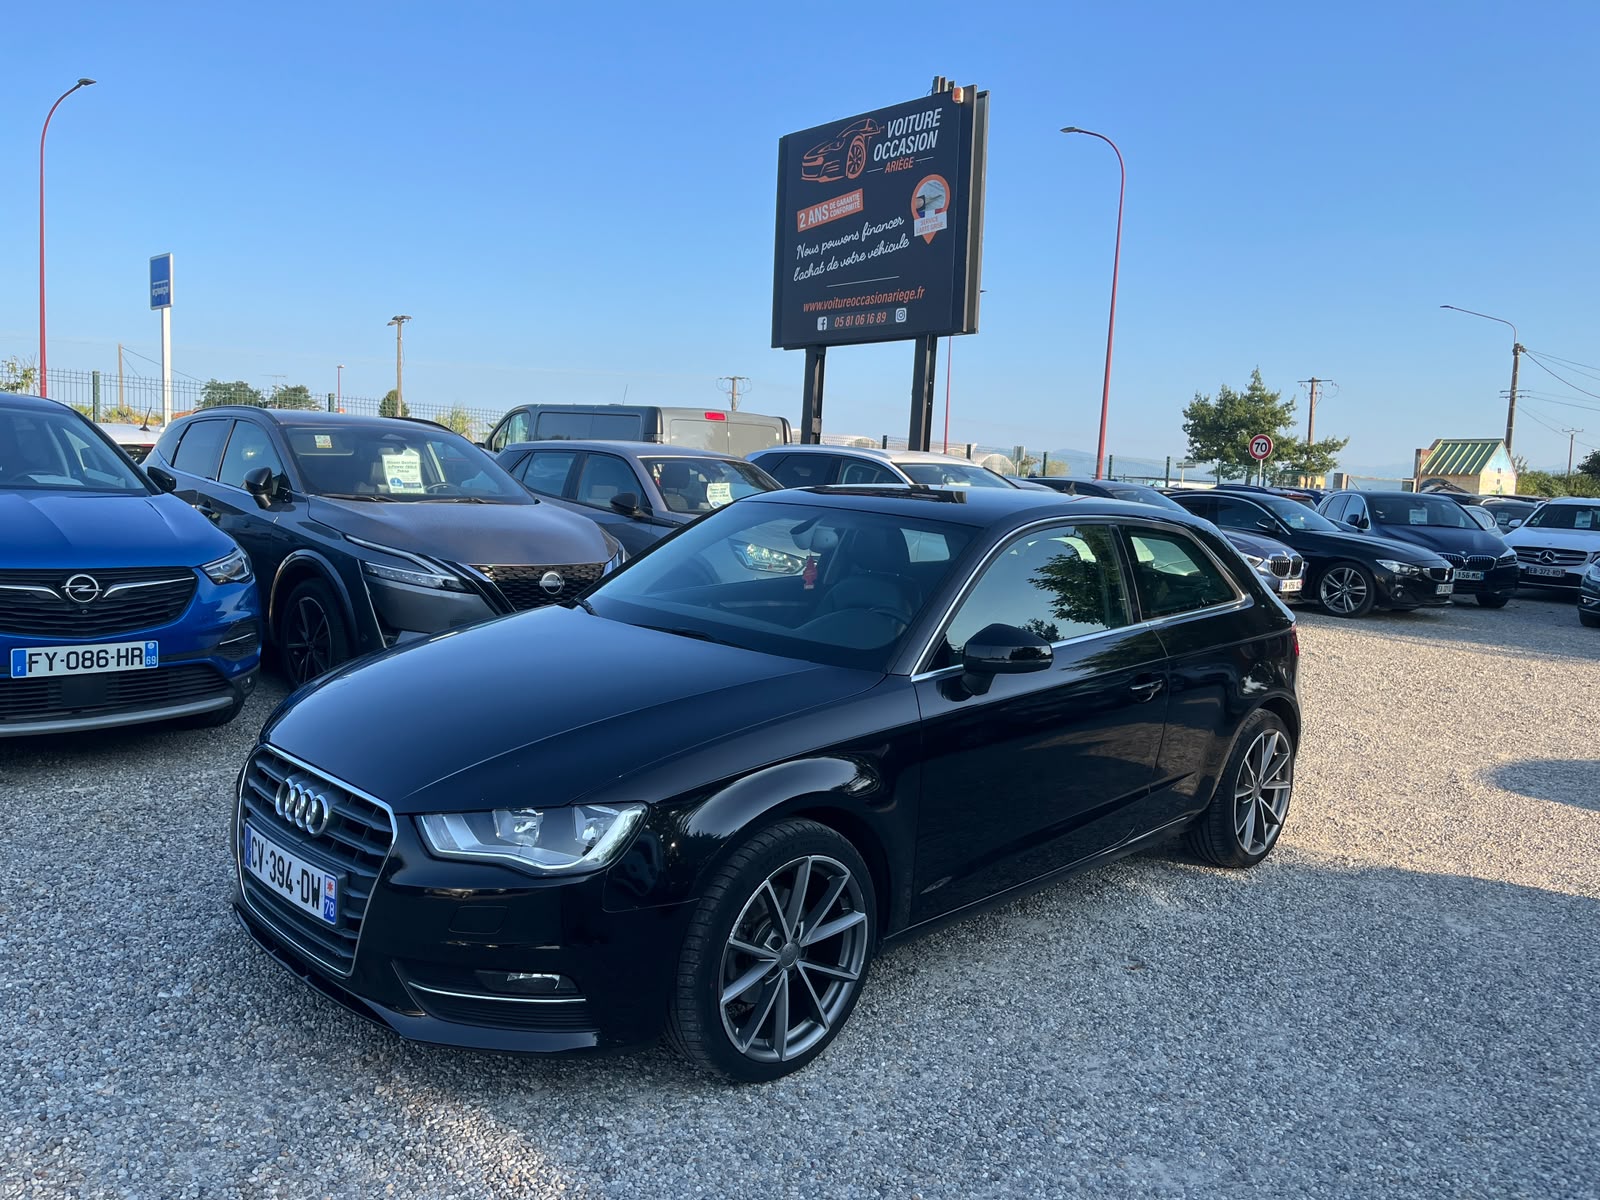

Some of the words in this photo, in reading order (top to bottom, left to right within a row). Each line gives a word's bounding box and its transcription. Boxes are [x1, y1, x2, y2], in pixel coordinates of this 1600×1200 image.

[887, 107, 943, 139] VOITURE
[873, 129, 939, 162] OCCASION
[884, 156, 915, 174] ARIÈGE
[799, 212, 807, 229] 2
[807, 204, 829, 226] ANS
[829, 202, 836, 210] DE
[796, 242, 820, 260] Nous
[820, 230, 860, 256] pouvons
[861, 216, 905, 242] financer
[826, 255, 839, 272] de
[840, 250, 867, 268] votre
[867, 232, 910, 259] véhicule
[803, 285, 926, 313] www.voitureoccasionariege.fr
[834, 316, 845, 328] 05
[845, 314, 855, 327] 81
[855, 313, 866, 326] 06
[866, 312, 876, 325] 16
[876, 311, 888, 324] 89
[1255, 442, 1268, 453] 70
[28, 647, 144, 673] FY-086-HR
[145, 655, 156, 666] 69
[252, 836, 321, 911] CV-394-DW
[324, 899, 335, 918] 78
